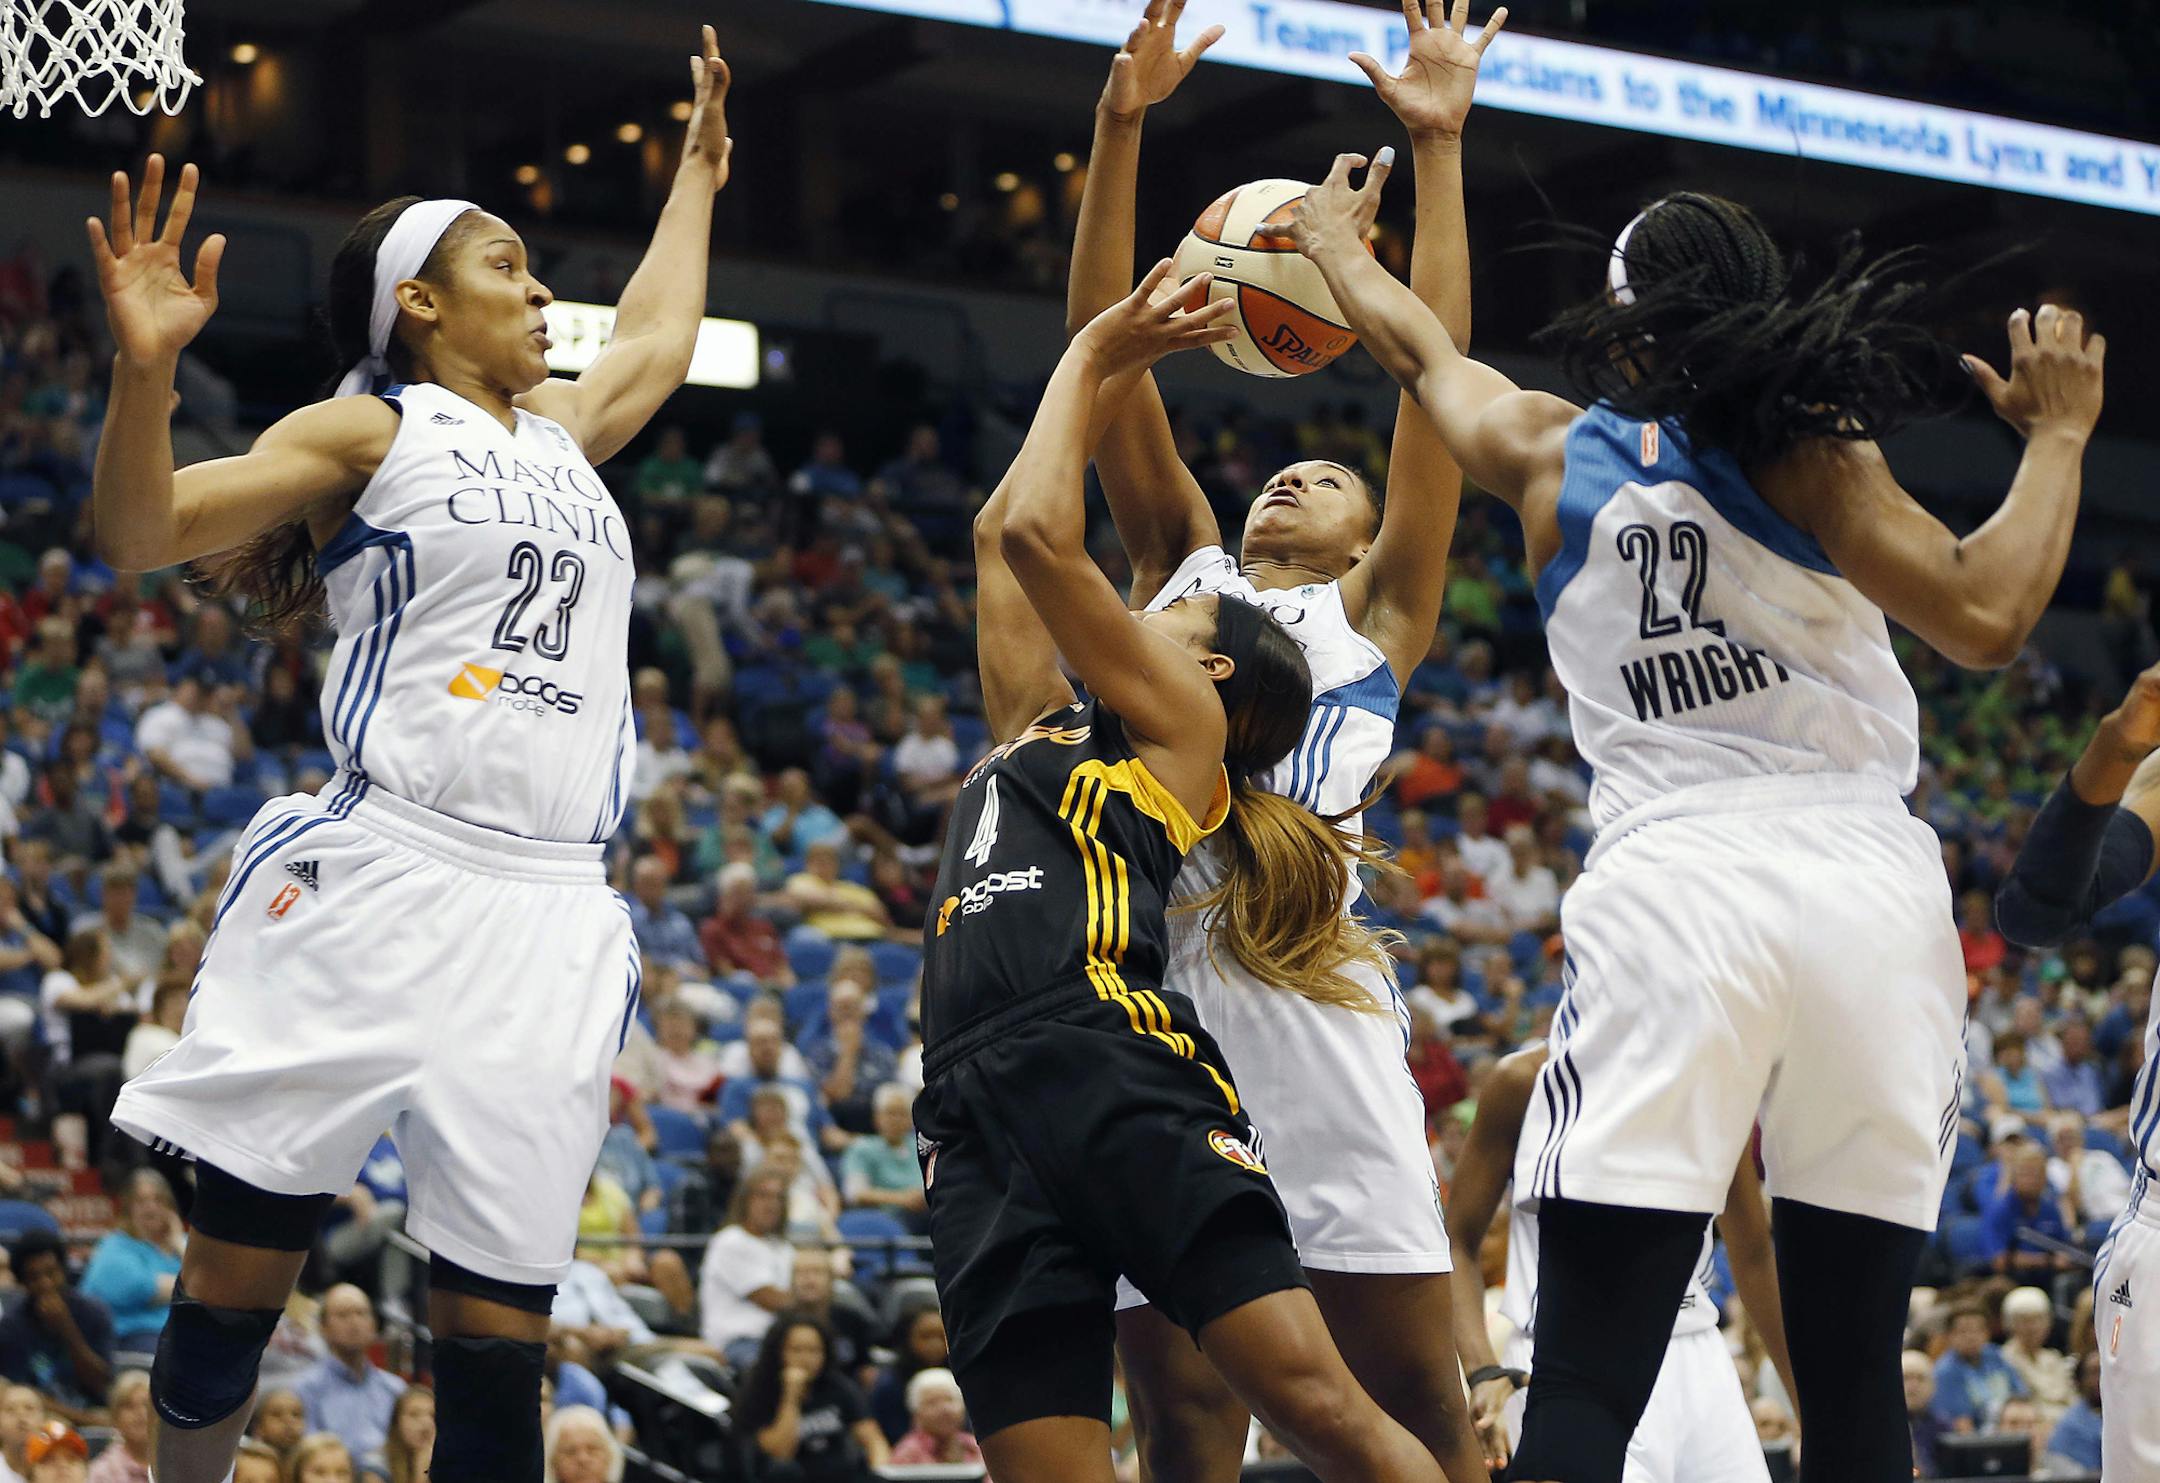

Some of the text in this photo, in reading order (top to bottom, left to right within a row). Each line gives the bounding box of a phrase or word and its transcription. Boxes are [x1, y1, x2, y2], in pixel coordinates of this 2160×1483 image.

[1250, 5, 1364, 55] Team
[1622, 71, 1660, 111] to
[1677, 78, 1736, 123] the
[1756, 89, 1951, 159] Minnesota
[1966, 125, 2046, 176] Lynx
[2067, 152, 2125, 187] and
[448, 450, 603, 501] MAYO
[448, 487, 625, 561] CLINIC
[491, 541, 585, 662] 23
[1617, 521, 1727, 640] 22
[964, 774, 999, 868] 4
